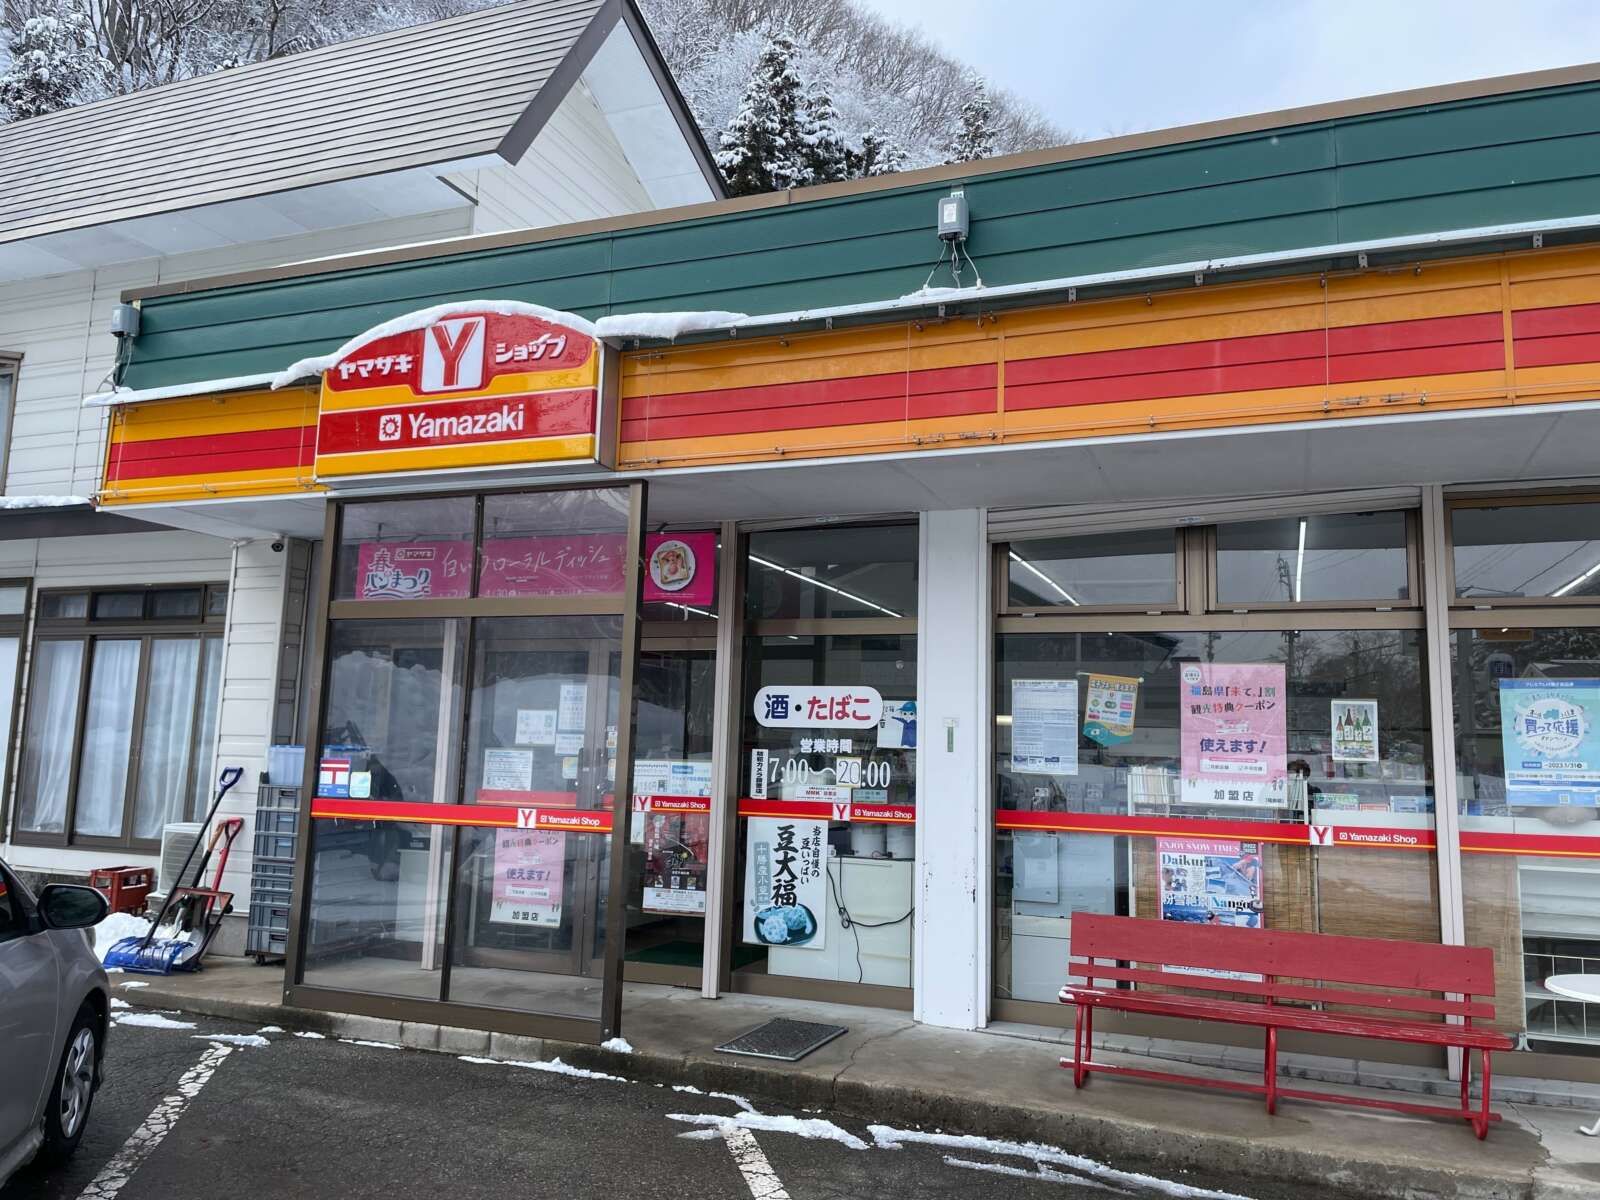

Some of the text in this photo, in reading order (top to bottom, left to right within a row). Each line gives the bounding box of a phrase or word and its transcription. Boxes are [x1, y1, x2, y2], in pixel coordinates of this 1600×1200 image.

[431, 320, 478, 387] Y
[495, 334, 566, 364] ショップ
[338, 354, 413, 380] ヤマザキ
[409, 404, 524, 439] Yamazaki
[764, 694, 871, 721] 酒・たばこ
[1191, 701, 1276, 715] 観光特典クーポン
[1525, 719, 1579, 736] 買って応援
[800, 739, 852, 753] 営業時間
[1214, 790, 1253, 801] 加盟店
[690, 801, 706, 810] Shop
[548, 815, 600, 828] Yamazaki Shop
[862, 809, 912, 821] Yamazaki Shop
[1349, 832, 1418, 845] Yamazaki Shop
[811, 825, 822, 878] 当店自慢の
[1160, 841, 1240, 852] ENJOY SNOW TIMES
[770, 824, 799, 908] 豆大福
[1162, 854, 1213, 868] Daikura
[1212, 896, 1250, 912] Nango
